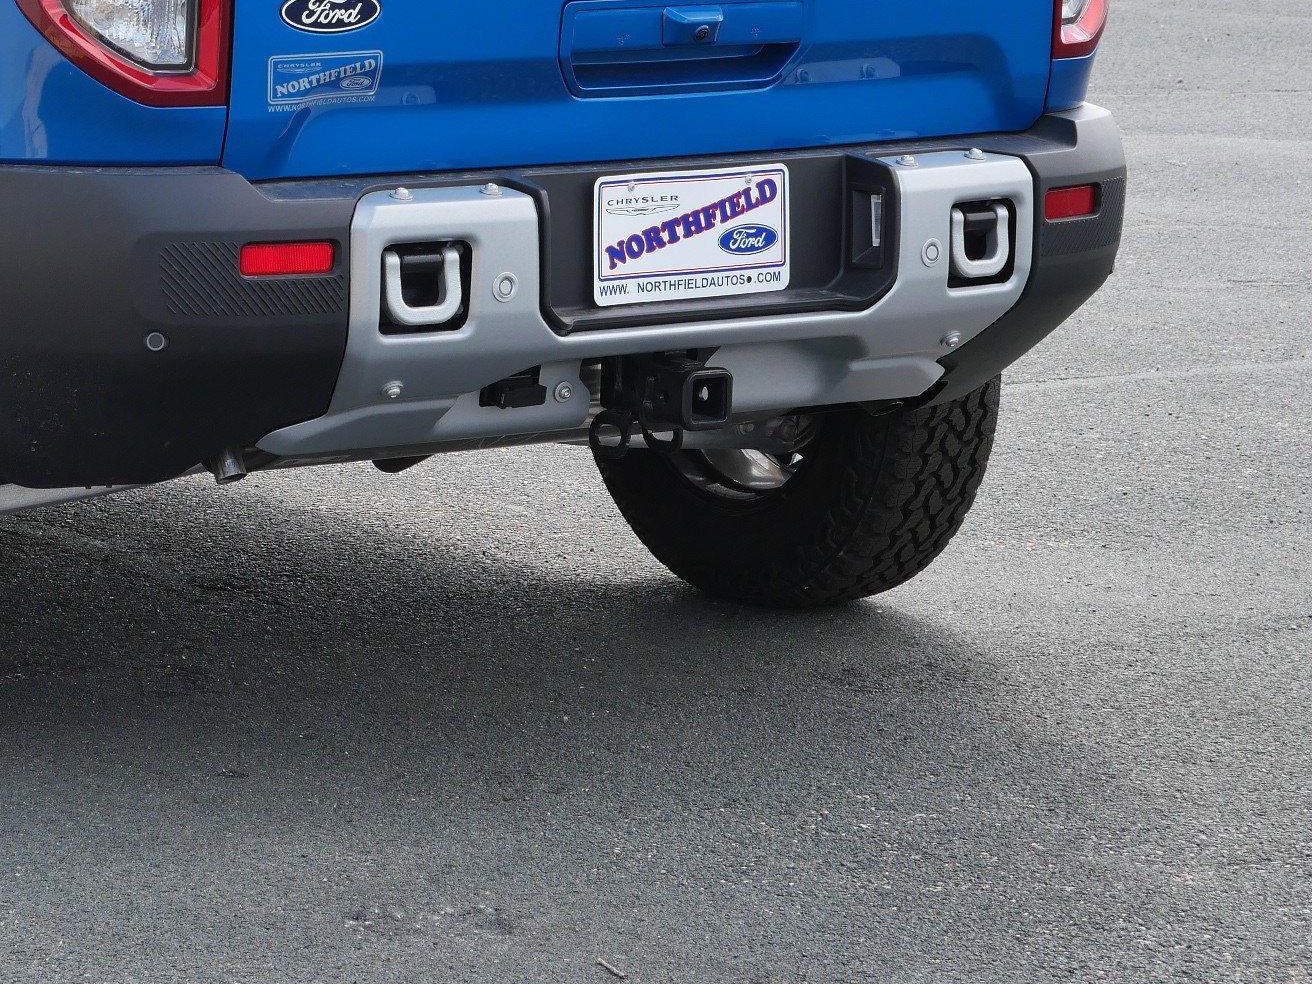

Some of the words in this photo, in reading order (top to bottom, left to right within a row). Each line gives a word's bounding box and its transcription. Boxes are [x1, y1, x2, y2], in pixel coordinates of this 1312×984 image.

[275, 58, 376, 98] NORTHFIELD
[345, 77, 367, 88] Ford
[268, 95, 375, 112] WWW.NORTHFIELDAUTOS.COM
[607, 195, 679, 206] CHRYSLER
[605, 178, 777, 270] NORTHFIELD
[729, 228, 766, 250] Ford
[637, 275, 746, 294] NORTHFIELDAUTOS
